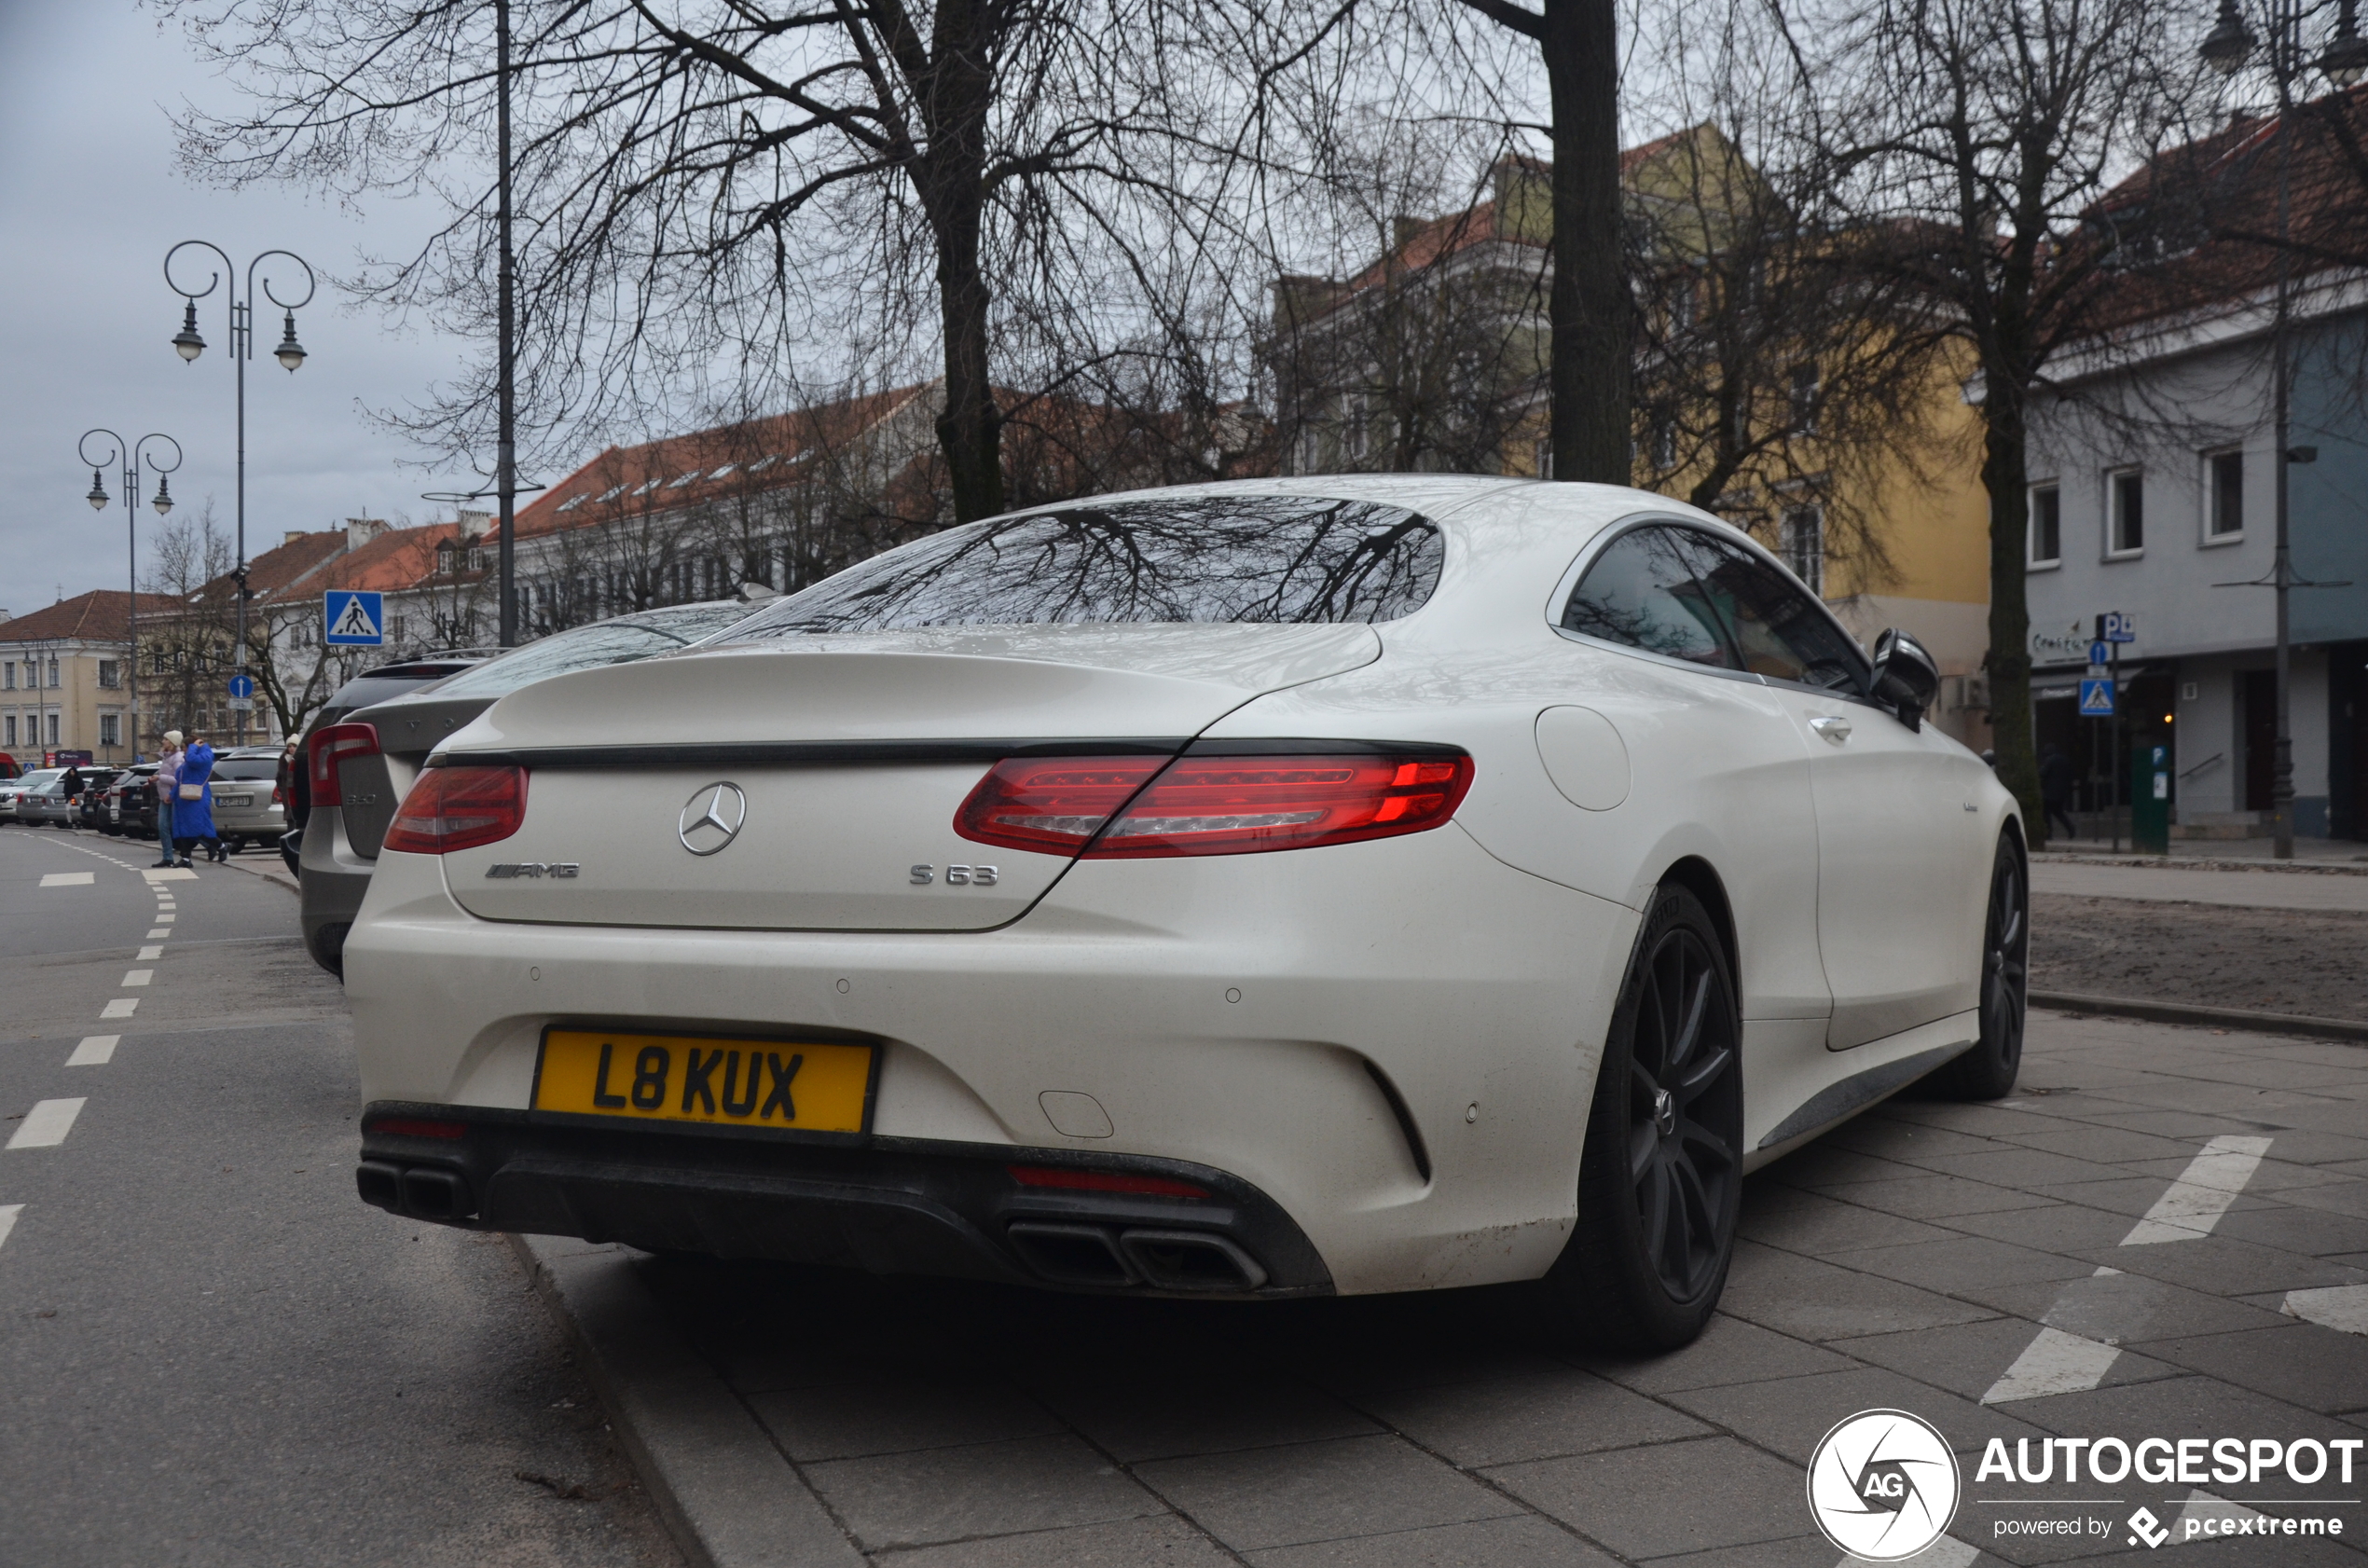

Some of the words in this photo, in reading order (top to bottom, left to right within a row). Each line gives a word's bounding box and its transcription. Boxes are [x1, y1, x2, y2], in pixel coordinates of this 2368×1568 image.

[2105, 615, 2120, 640] P
[514, 862, 580, 878] AMG
[910, 864, 933, 884] S
[945, 864, 998, 886] 63
[594, 1043, 670, 1109] L8
[681, 1048, 804, 1120] KUX
